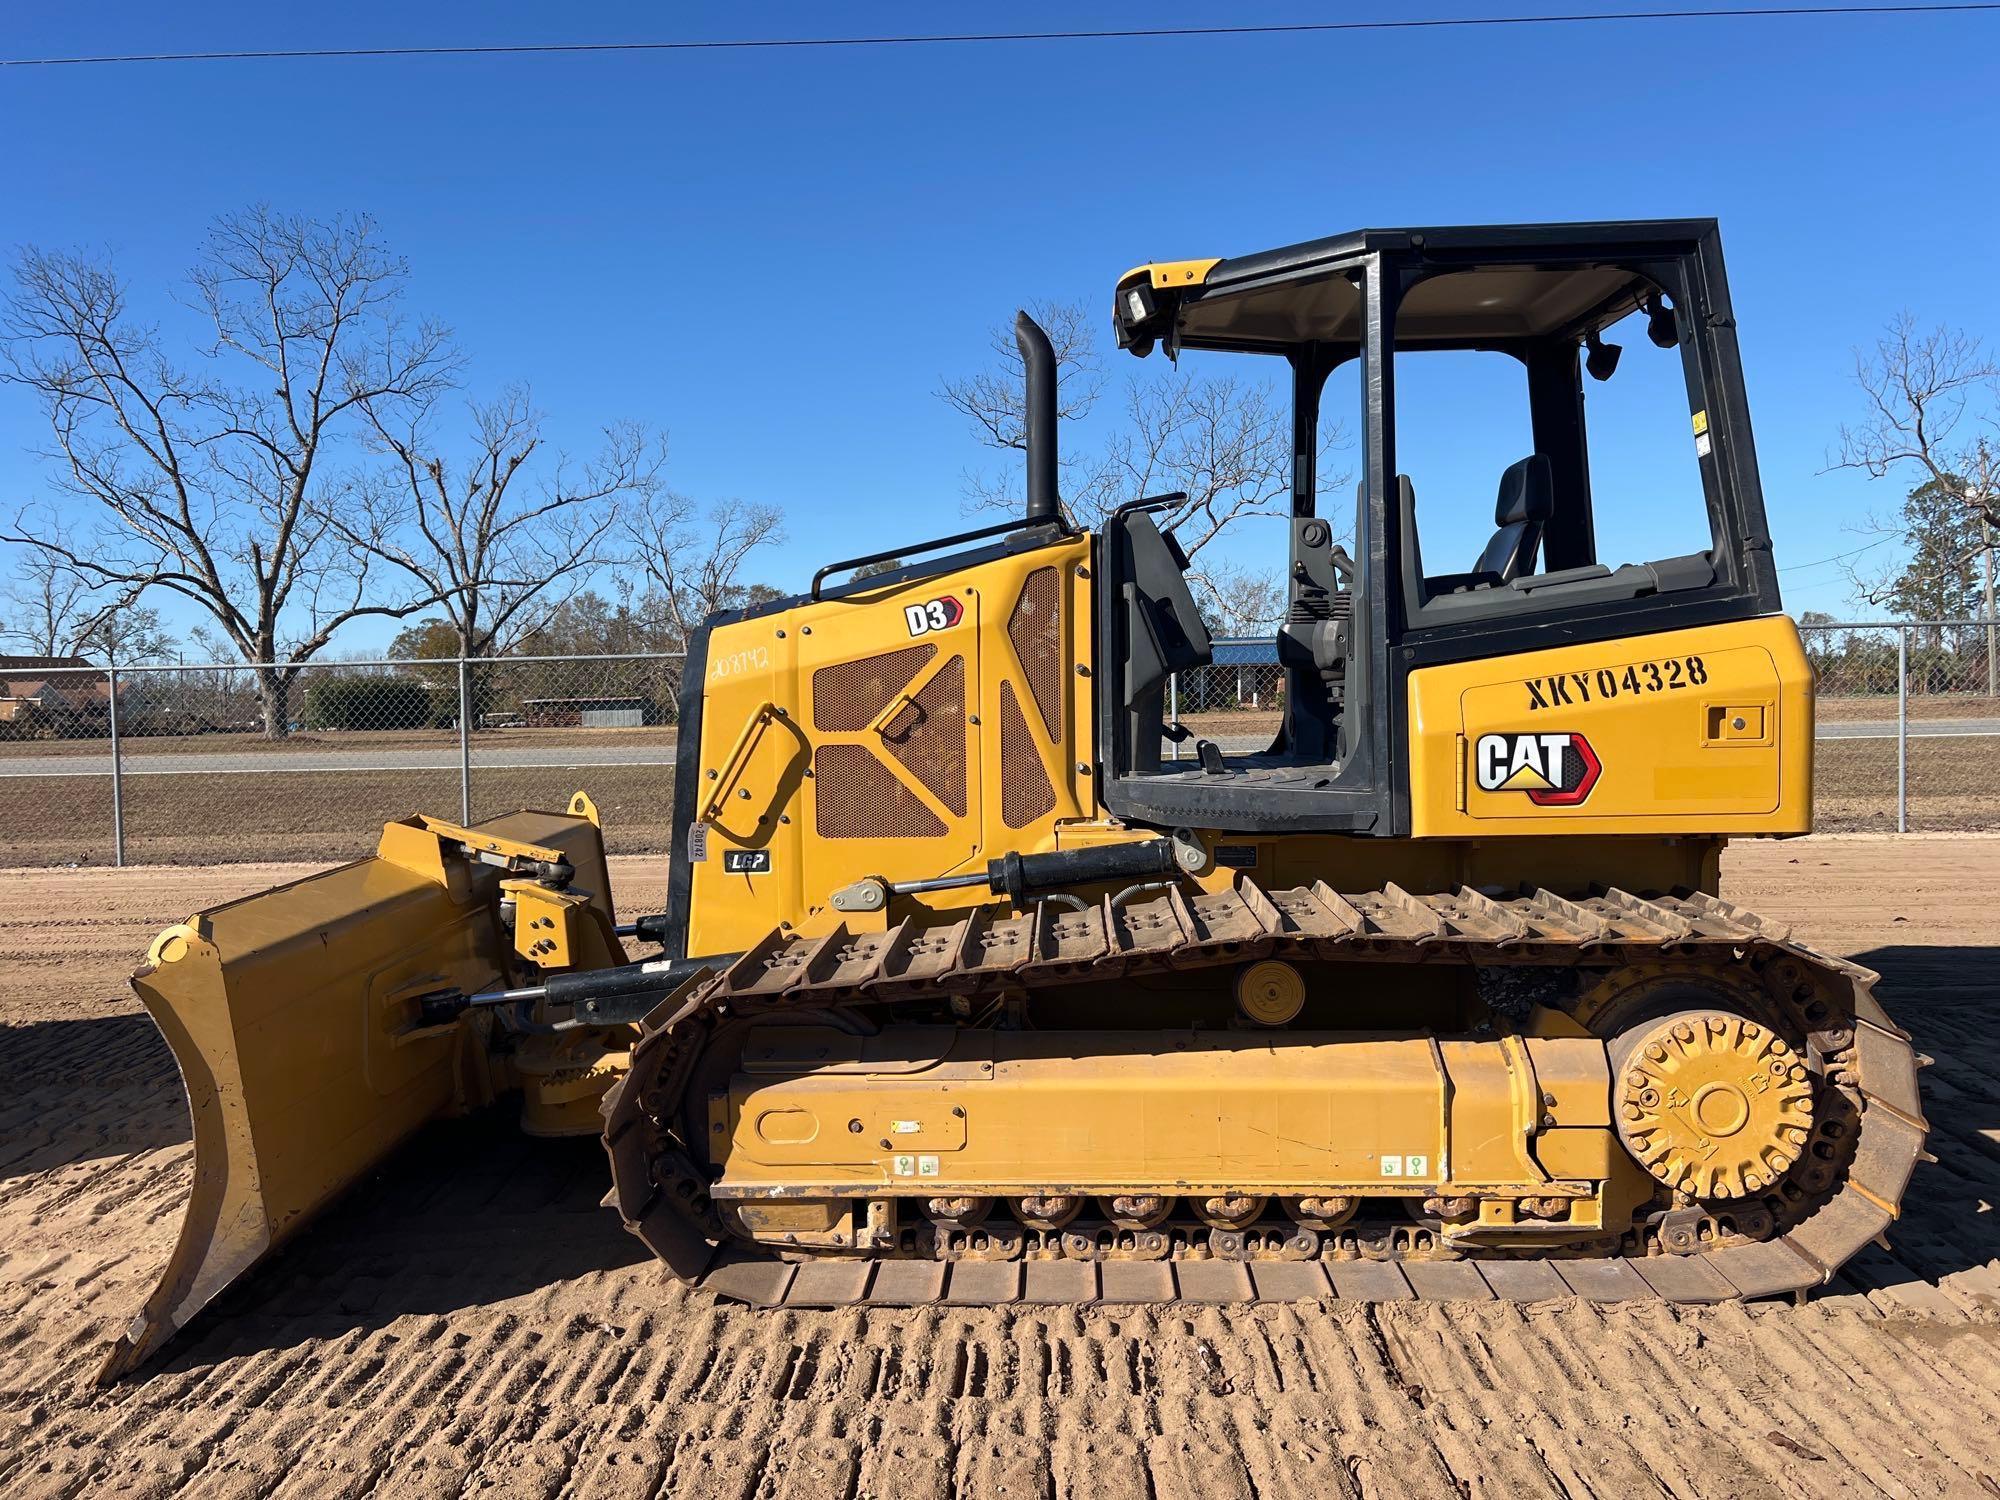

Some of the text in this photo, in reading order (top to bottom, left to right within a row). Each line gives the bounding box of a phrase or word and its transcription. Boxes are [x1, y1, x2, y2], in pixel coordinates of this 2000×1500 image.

[904, 600, 947, 635] D3
[711, 646, 768, 680] 208742
[1525, 656, 1707, 710] XKY04328
[1477, 734, 1570, 789] CAT
[694, 829, 704, 858] 208742
[731, 853, 765, 869] LGP
